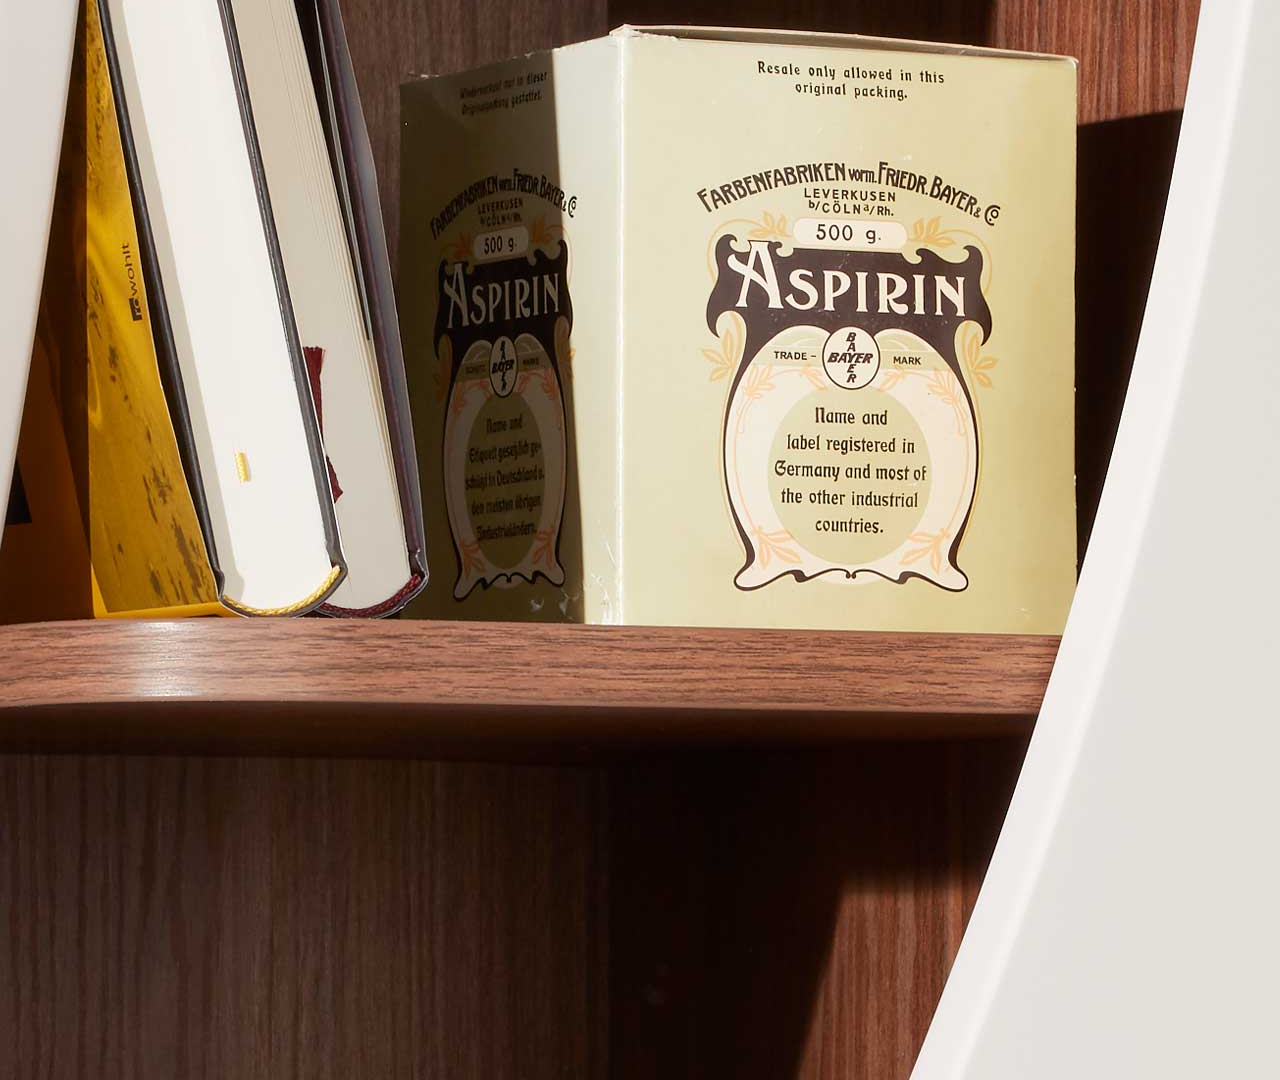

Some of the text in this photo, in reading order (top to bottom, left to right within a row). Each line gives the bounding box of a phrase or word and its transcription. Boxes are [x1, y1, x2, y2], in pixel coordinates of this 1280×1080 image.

[757, 60, 945, 84] Resale only allowed in this
[795, 81, 908, 101] original packing.
[696, 162, 846, 213] FARBENFABRIKEN
[848, 166, 877, 183] vorm.
[877, 161, 929, 195] FRIEDR.
[929, 175, 977, 213] BAYER
[803, 187, 897, 202] LEVERKUSEN
[816, 223, 882, 244] 500 g.
[484, 236, 518, 254] 500 g.
[122, 242, 142, 321] rowohlt
[727, 240, 966, 317] ASPIRIN
[444, 263, 560, 328] ASPIRIN
[774, 351, 921, 366] TRADE MARK
[827, 351, 874, 365] BAYER
[814, 407, 888, 426] Name and
[786, 432, 915, 456] label registered in
[774, 460, 927, 482] Germany and most of
[780, 488, 919, 508] the other industrial
[815, 517, 884, 534] countries.
